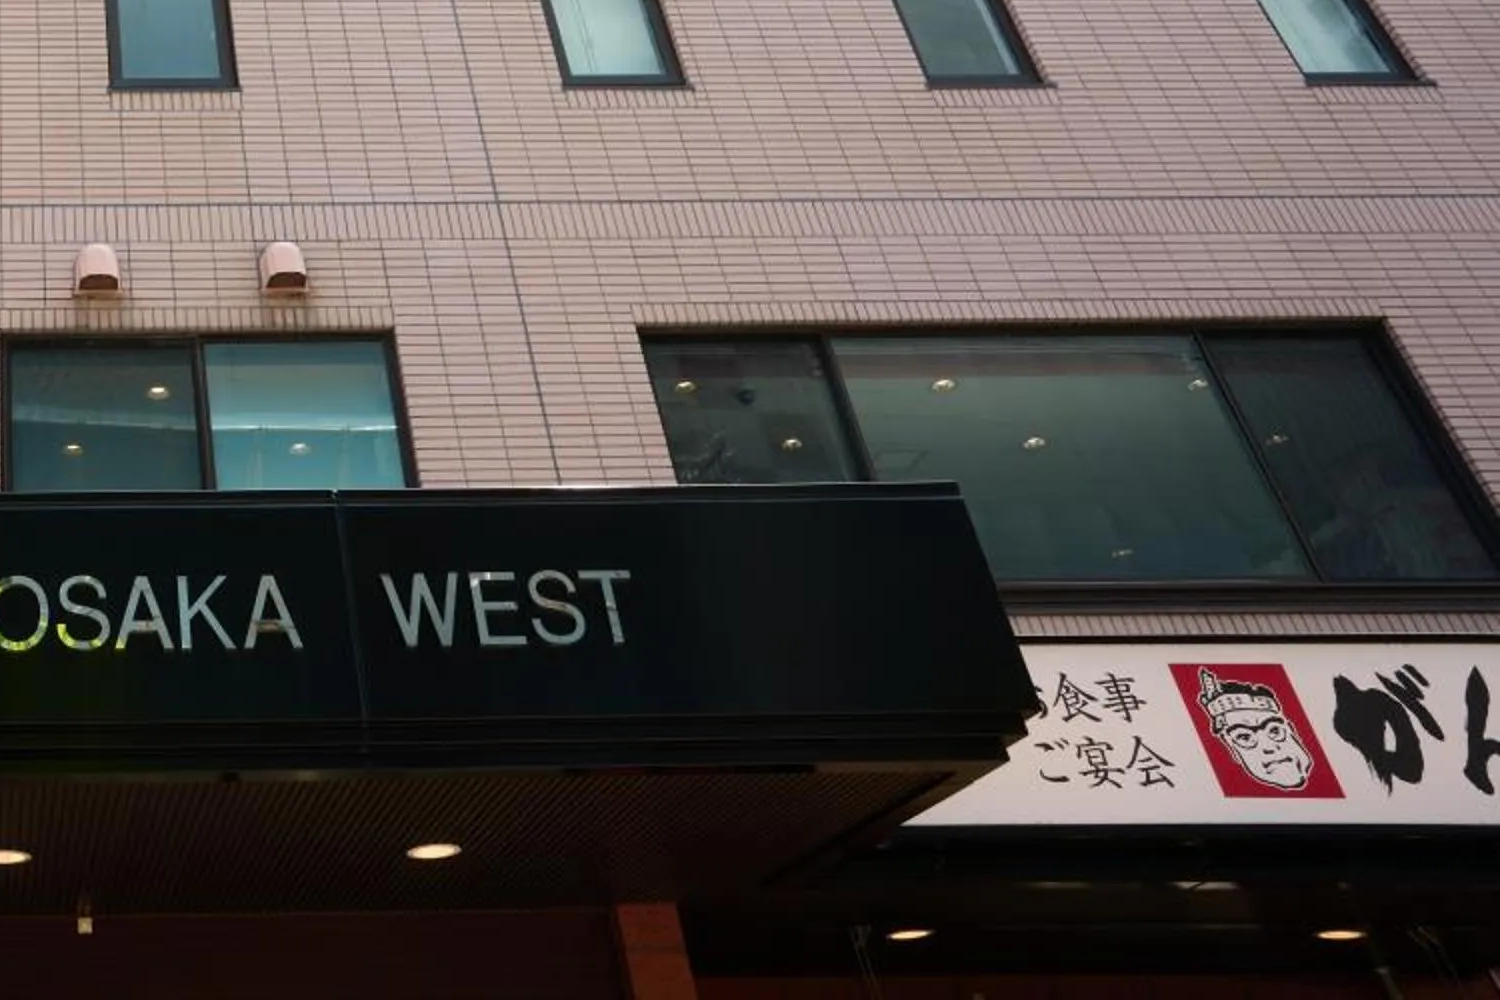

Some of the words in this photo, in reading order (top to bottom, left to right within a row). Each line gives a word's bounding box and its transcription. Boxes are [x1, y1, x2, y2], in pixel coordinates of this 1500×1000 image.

[380, 569, 631, 647] WEST
[1034, 735, 1176, 789] ご宴会
